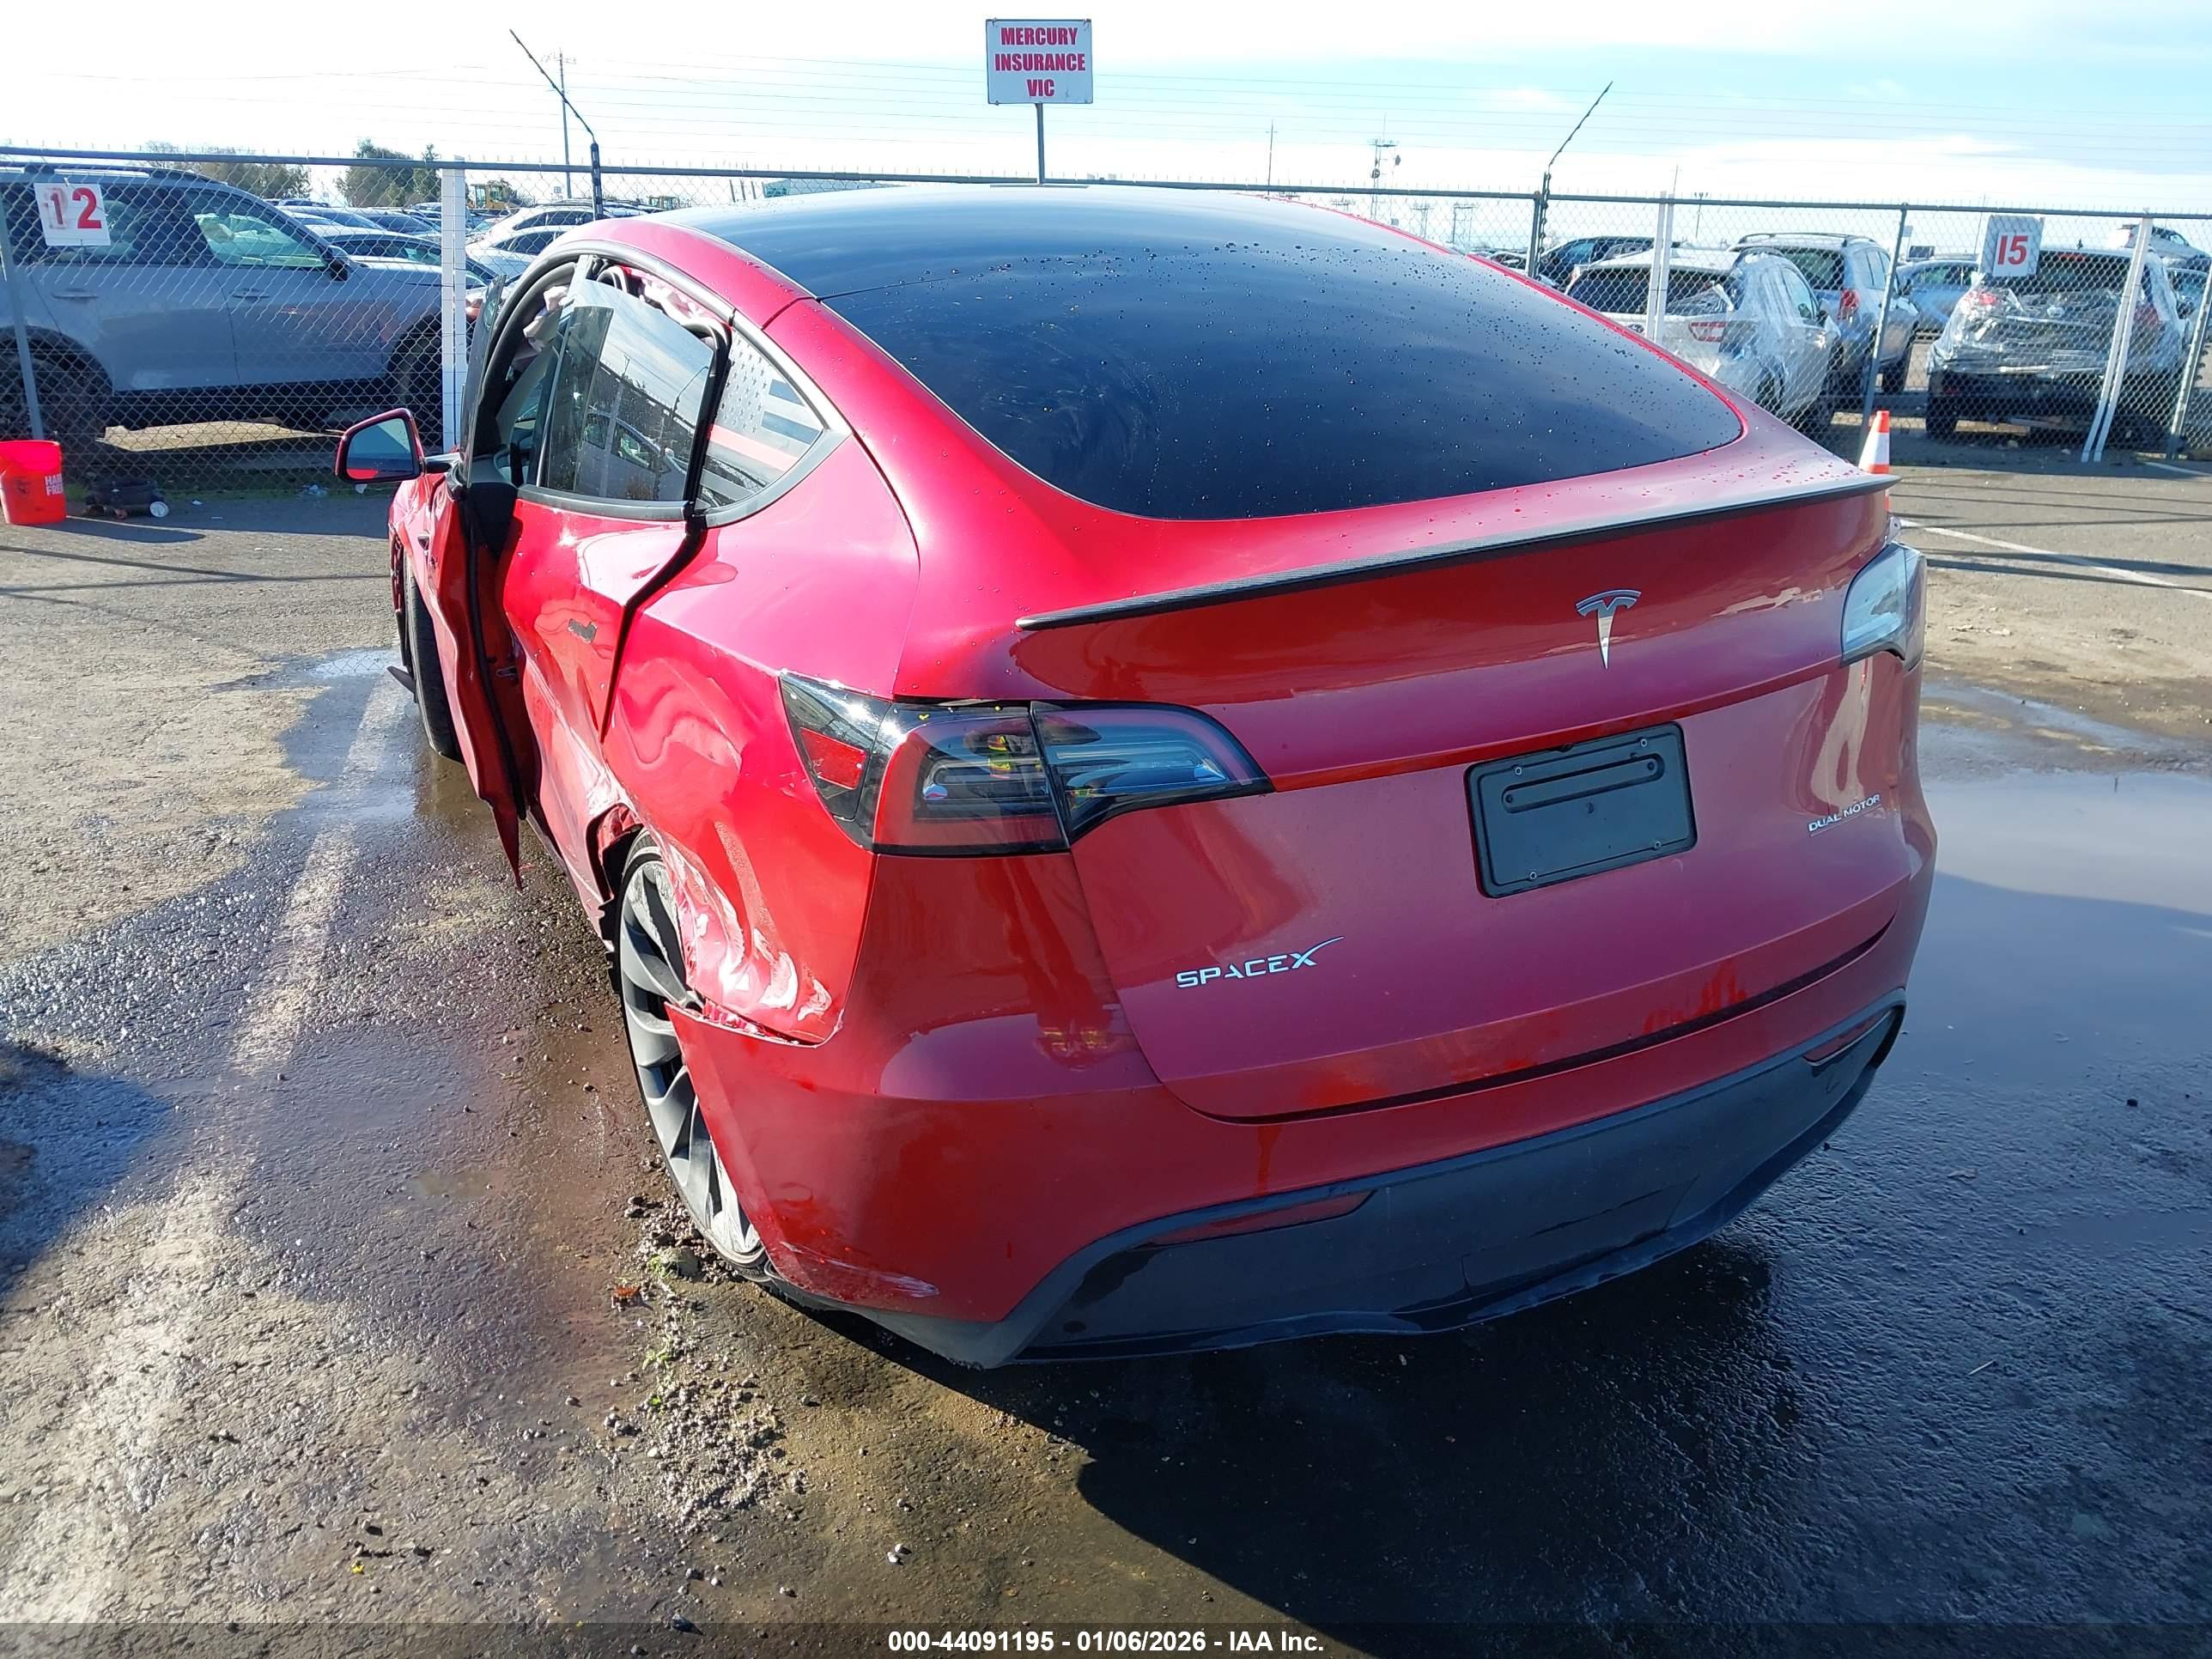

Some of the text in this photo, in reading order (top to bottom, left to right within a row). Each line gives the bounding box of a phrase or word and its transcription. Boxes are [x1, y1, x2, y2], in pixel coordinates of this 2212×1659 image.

[1000, 27, 1079, 46] MERCURY
[994, 53, 1086, 71] INSURANCE
[1027, 79, 1055, 97] VIC
[50, 186, 102, 229] 12
[1997, 234, 2028, 265] 15
[1808, 793, 1881, 832] DUAL MOTOR
[1176, 935, 1346, 988] SPACEX
